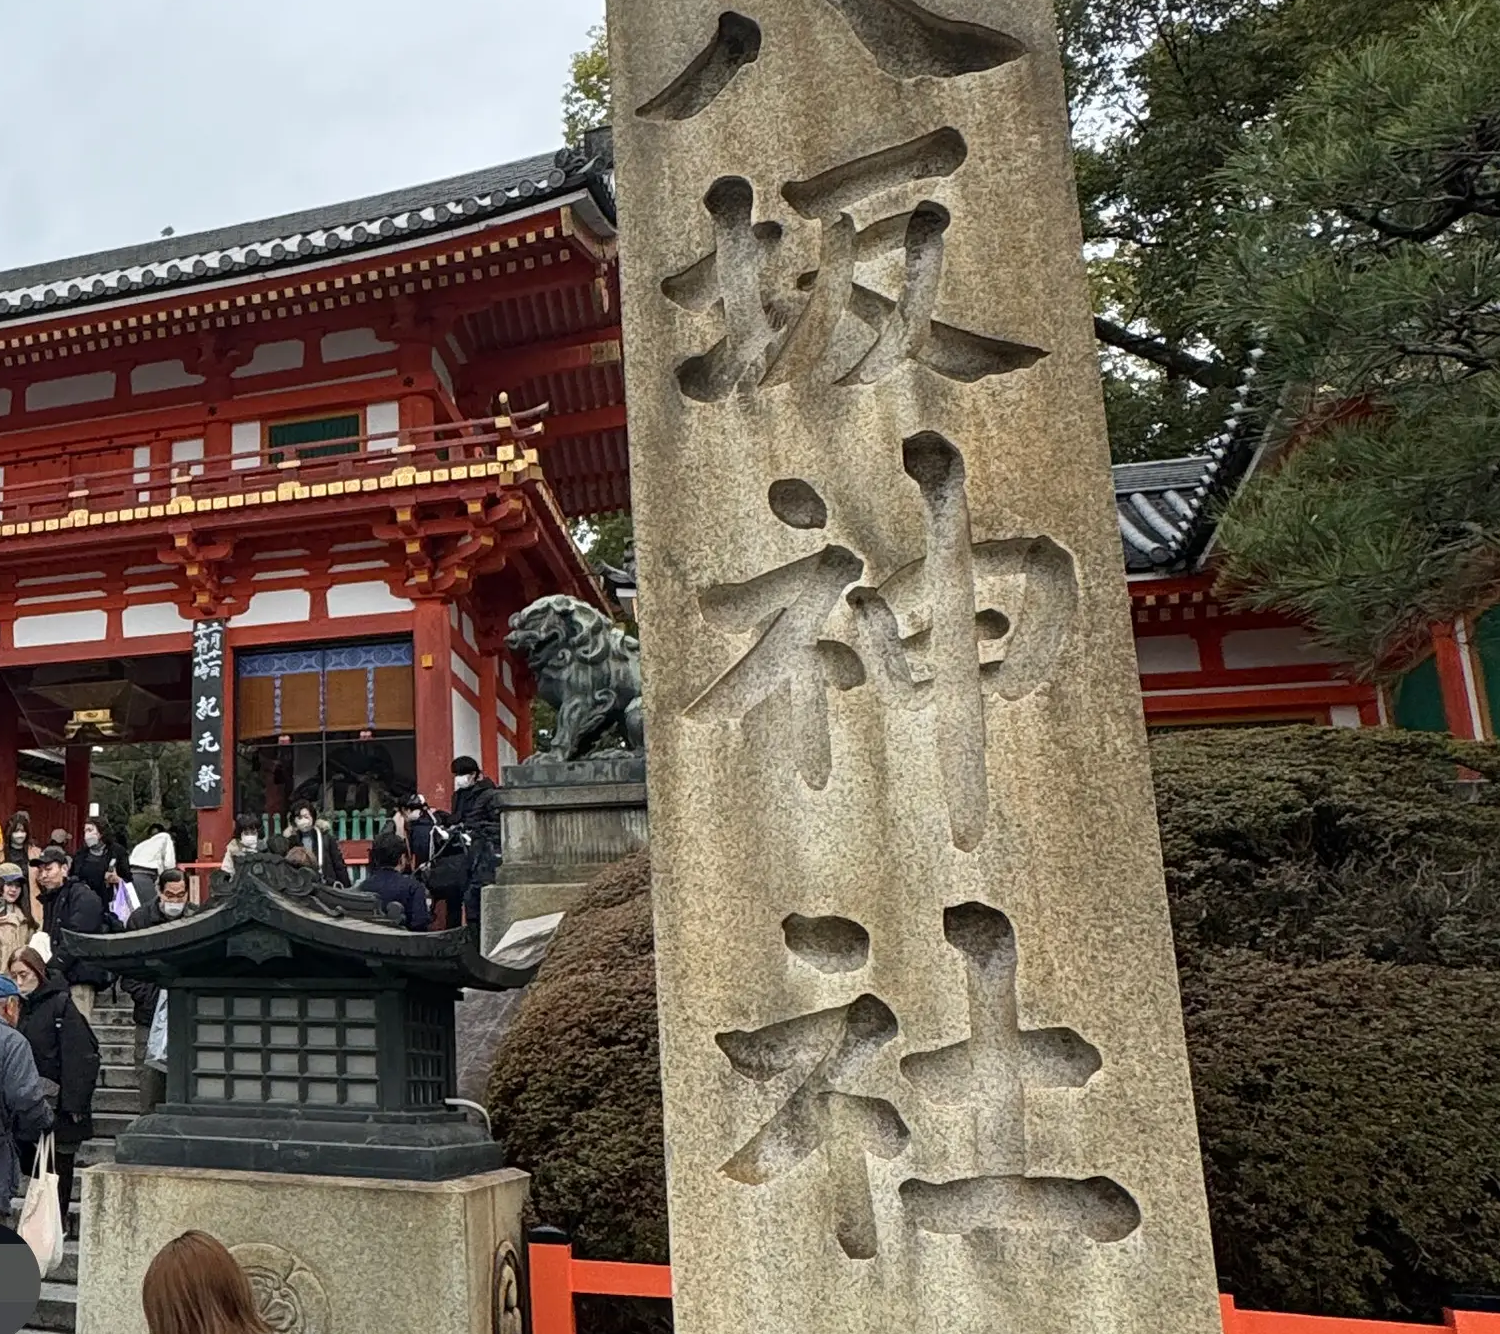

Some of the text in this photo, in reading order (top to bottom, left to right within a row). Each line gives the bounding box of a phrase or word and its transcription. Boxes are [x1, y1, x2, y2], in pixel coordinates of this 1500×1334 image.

[193, 622, 210, 681] 午前十時
[207, 621, 223, 678] 二月十一日
[195, 695, 221, 793] 紀元祭
